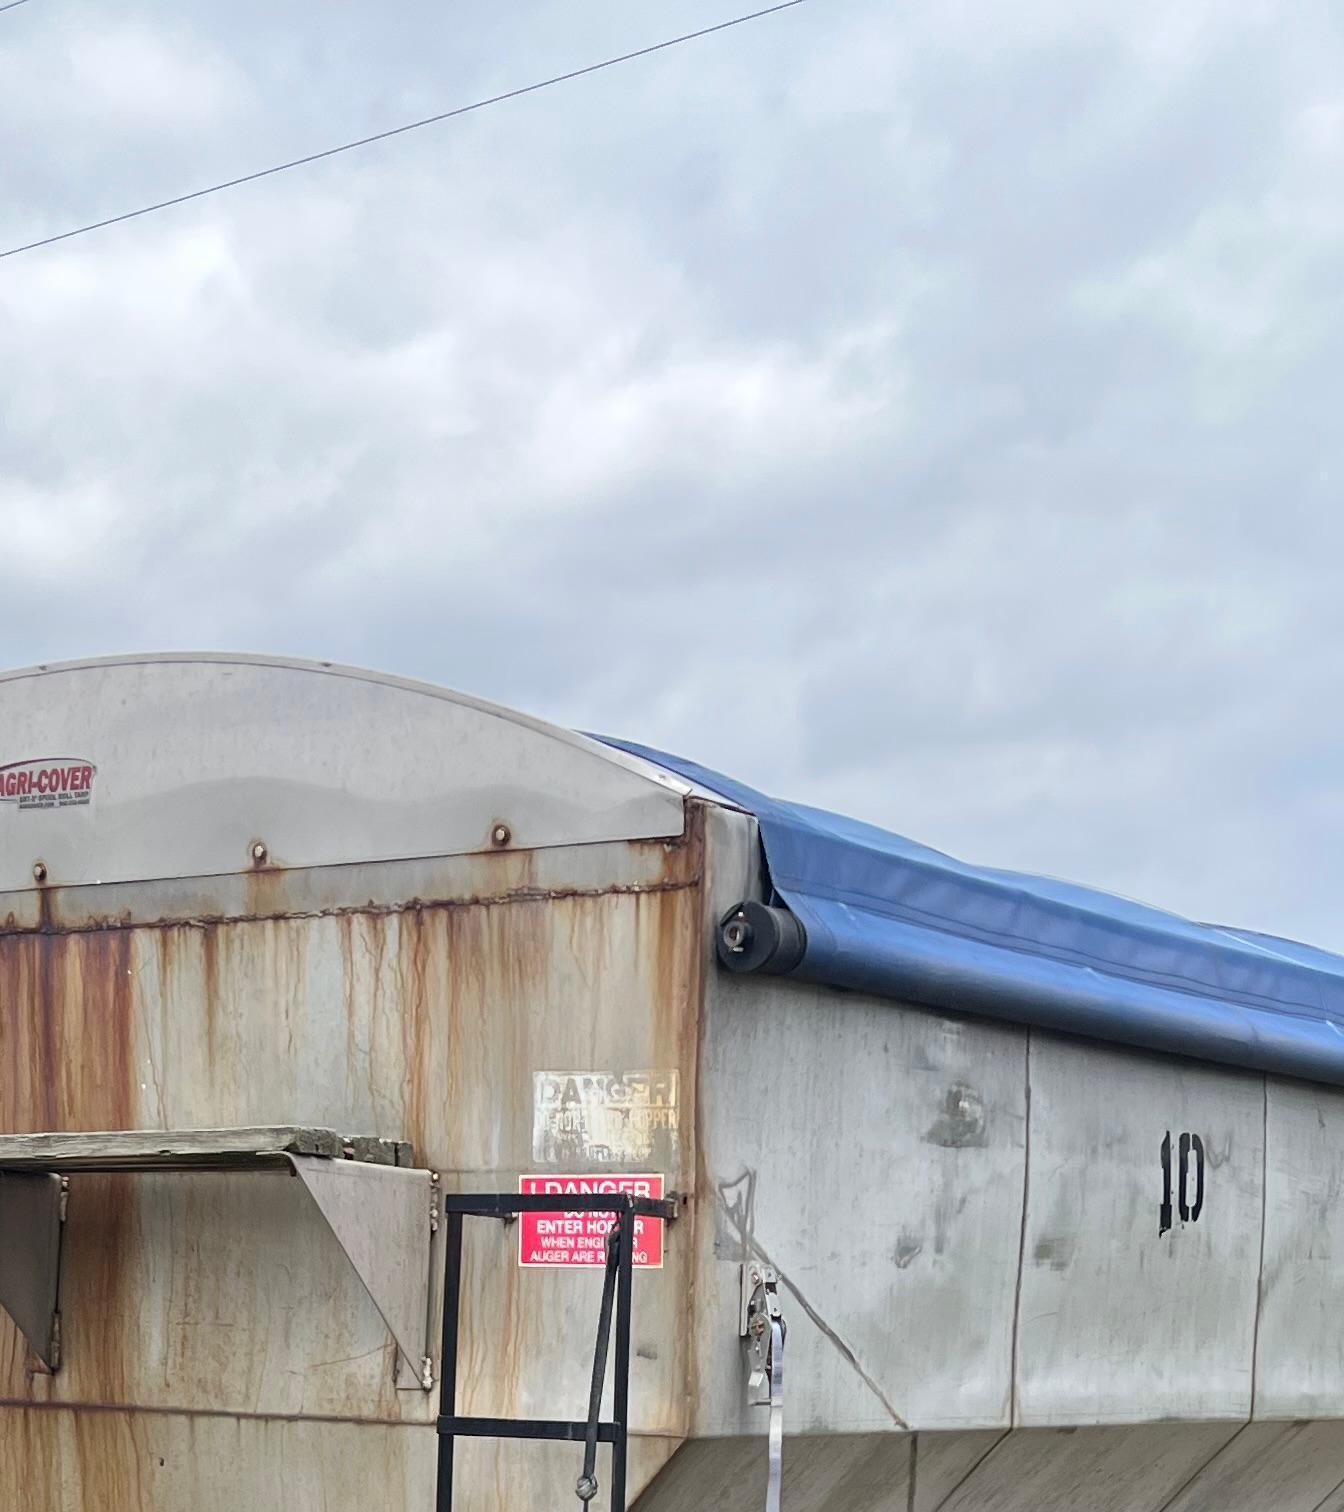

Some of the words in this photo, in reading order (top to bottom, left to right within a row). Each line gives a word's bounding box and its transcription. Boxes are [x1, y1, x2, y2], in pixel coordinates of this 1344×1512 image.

[1159, 1130, 1204, 1238] 10
[537, 1220, 583, 1234] ENTER
[541, 1237, 574, 1248] WHEN
[530, 1250, 569, 1263] AUGER
[571, 1250, 594, 1263] ARE
